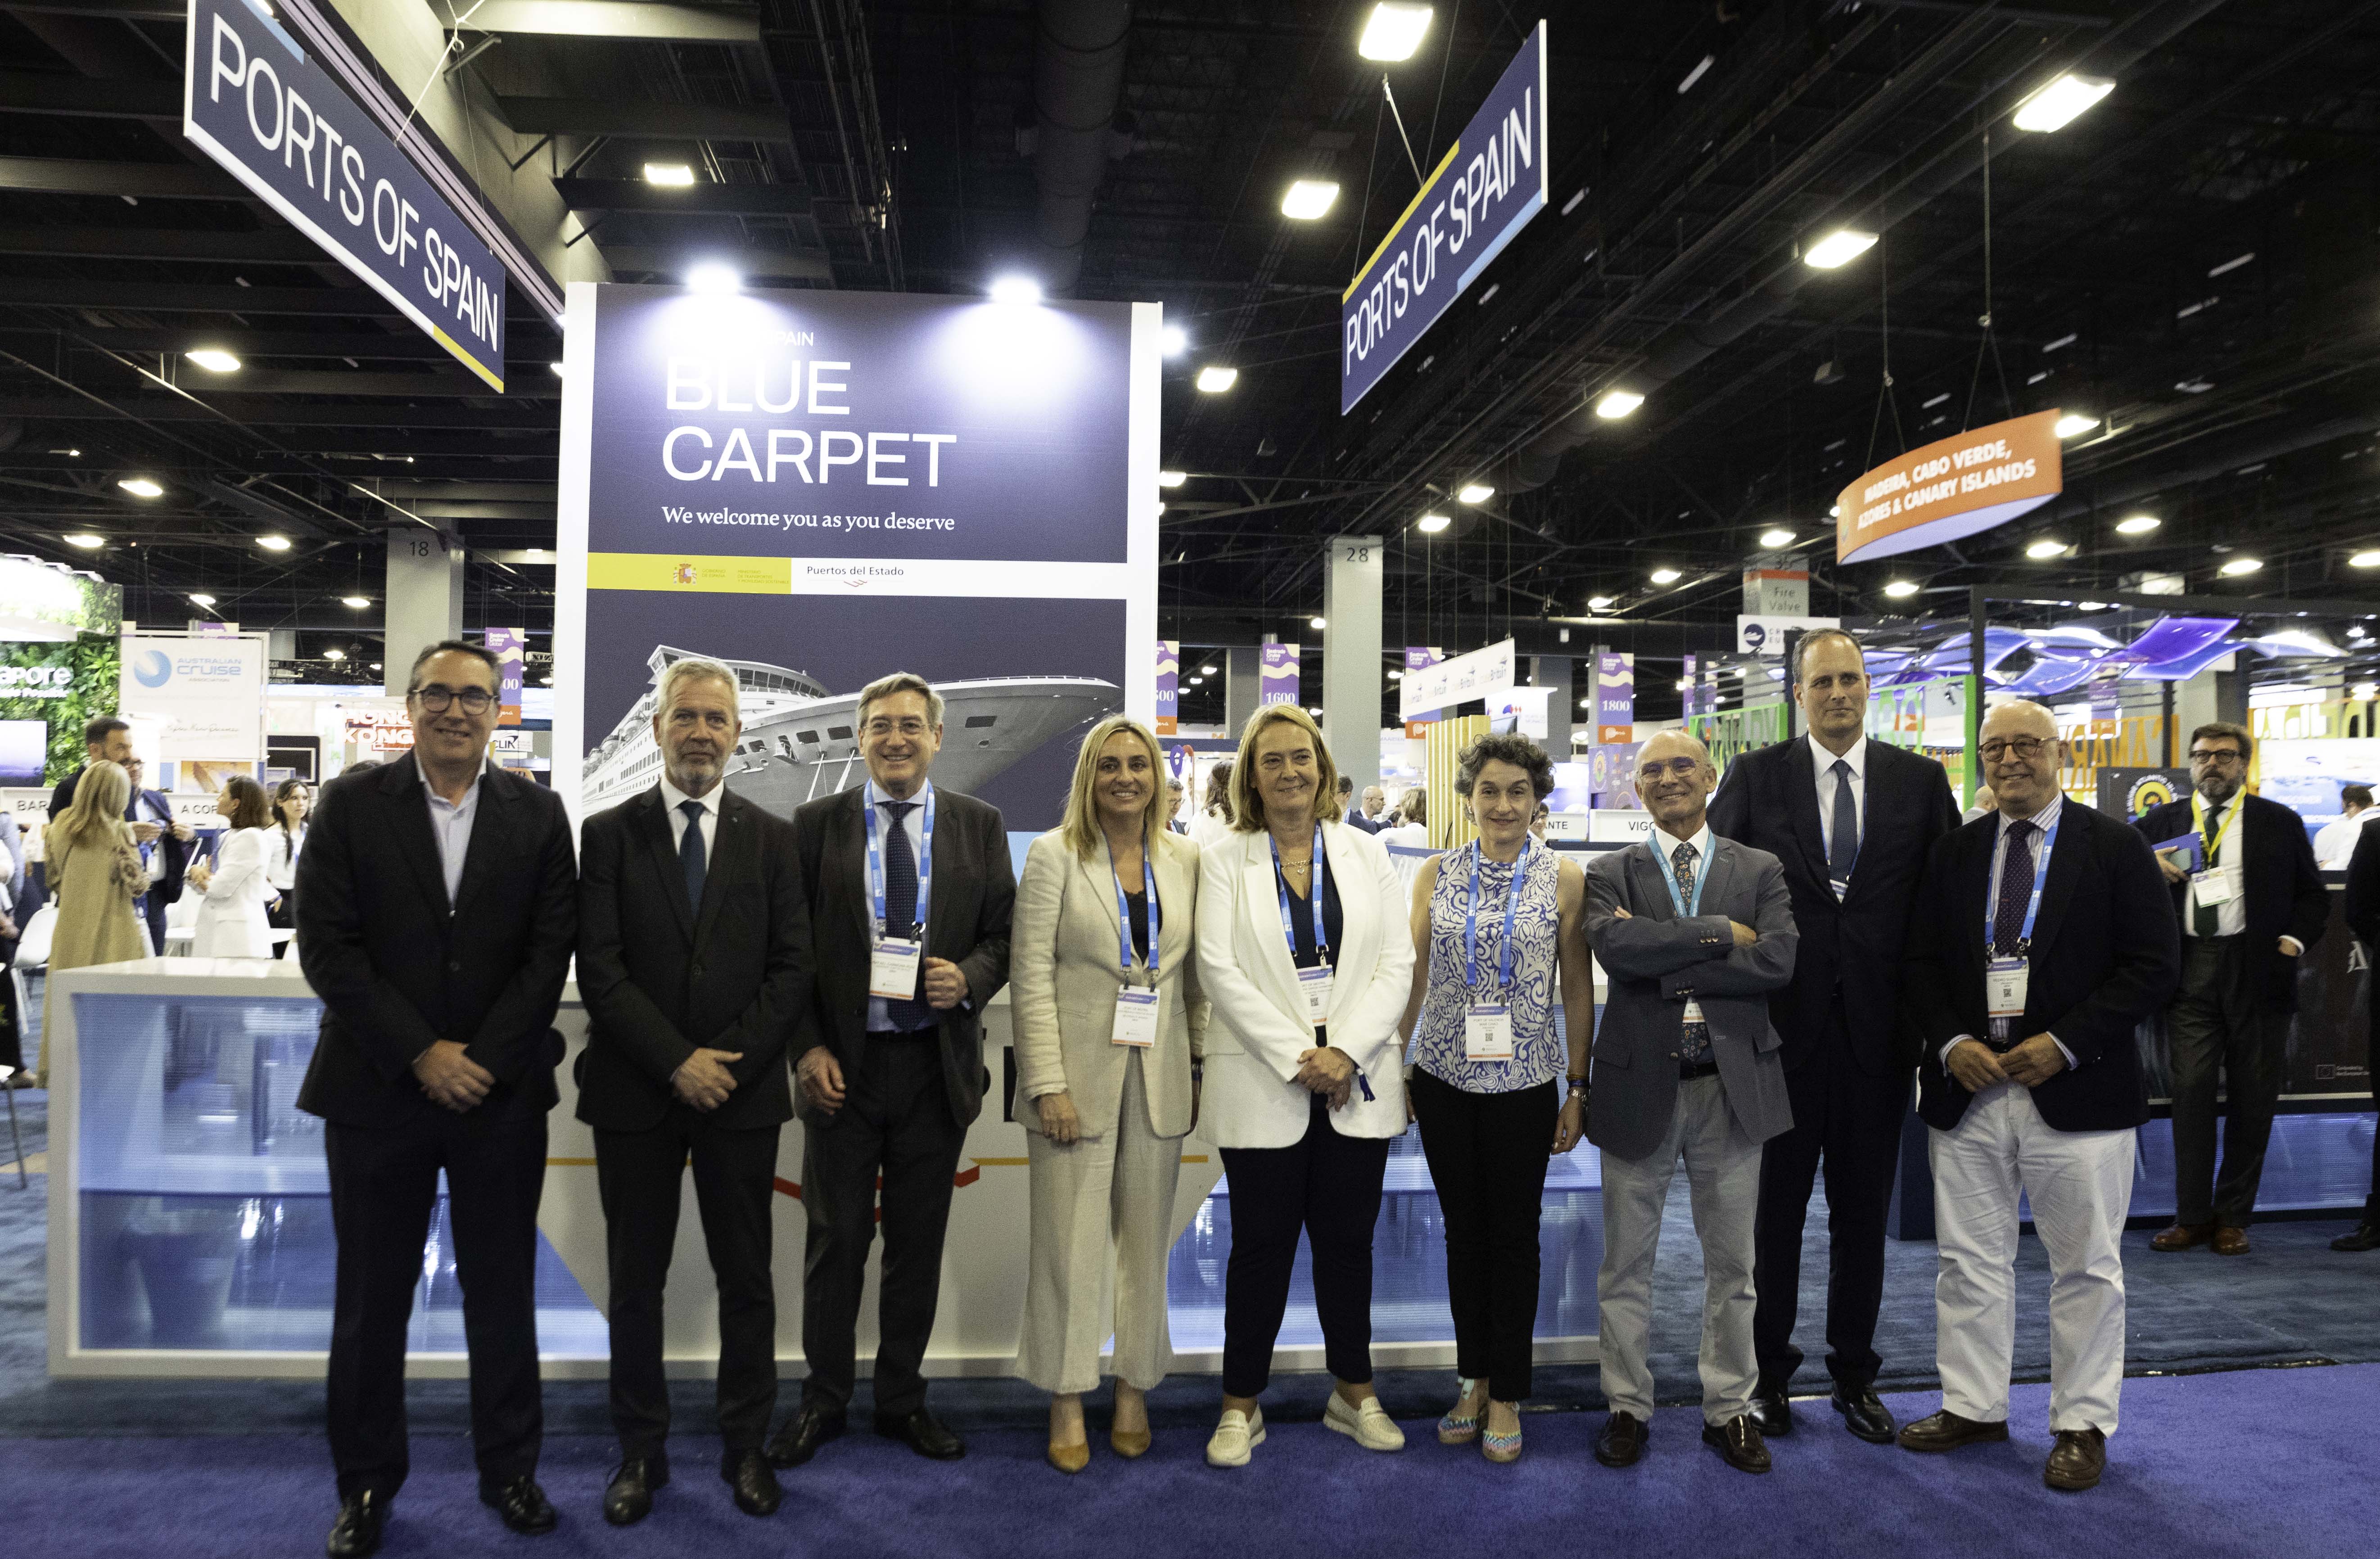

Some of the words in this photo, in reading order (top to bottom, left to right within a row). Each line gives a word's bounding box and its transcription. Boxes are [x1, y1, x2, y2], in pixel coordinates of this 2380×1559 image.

[211, 12, 365, 226] PORTS
[373, 178, 419, 267] OF
[424, 227, 497, 352] SPAIN
[1346, 250, 1409, 376] PORTS
[1413, 200, 1445, 297] OF
[1450, 86, 1531, 255] SPAIN
[772, 331, 814, 346] PAIN
[666, 357, 851, 415] BLUE
[662, 425, 957, 487] CARPET
[1864, 471, 1911, 505] MADEIRA,
[1912, 456, 1951, 484] CABO
[1953, 439, 2012, 470] VERDE,
[1892, 500, 1902, 516] &
[1903, 477, 1959, 511] CANARY
[1961, 458, 2036, 494] ISLANDS
[662, 506, 693, 524] We
[695, 507, 780, 527] welcome
[782, 512, 818, 531] you
[822, 514, 842, 528] as
[845, 514, 881, 532] you
[884, 512, 955, 530] deserve
[410, 541, 429, 556] 18
[1347, 547, 1368, 562] 28
[807, 566, 847, 576] Puertos
[849, 566, 866, 576] del
[869, 566, 904, 576] Estado
[1775, 587, 1794, 597] Fire
[1266, 692, 1295, 704] 1600
[1603, 700, 1630, 711] 1800
[345, 709, 413, 725] HONG
[345, 728, 415, 744] KONG
[181, 805, 189, 814] A
